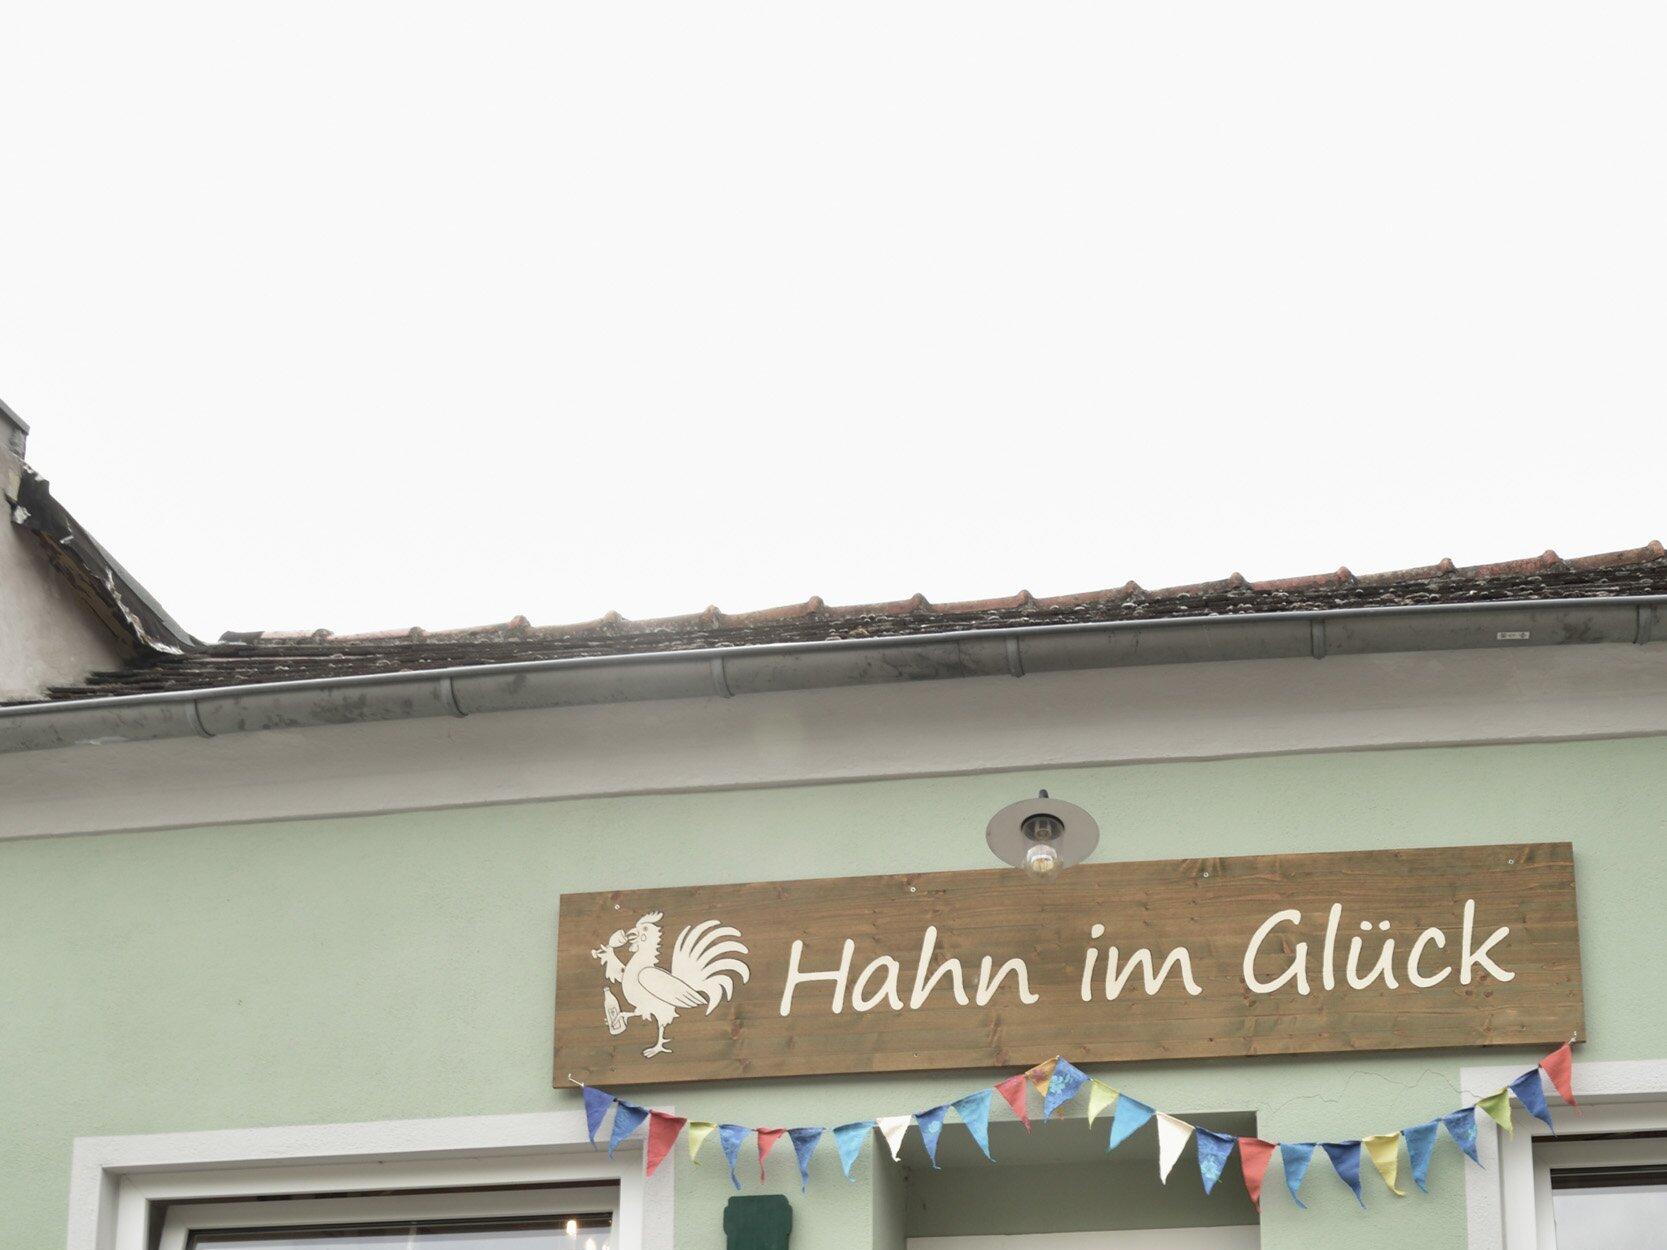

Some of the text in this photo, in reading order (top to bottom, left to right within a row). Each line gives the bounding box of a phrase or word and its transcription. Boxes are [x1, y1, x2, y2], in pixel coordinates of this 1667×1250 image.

[779, 899, 1516, 1017] Hahn im Glück
